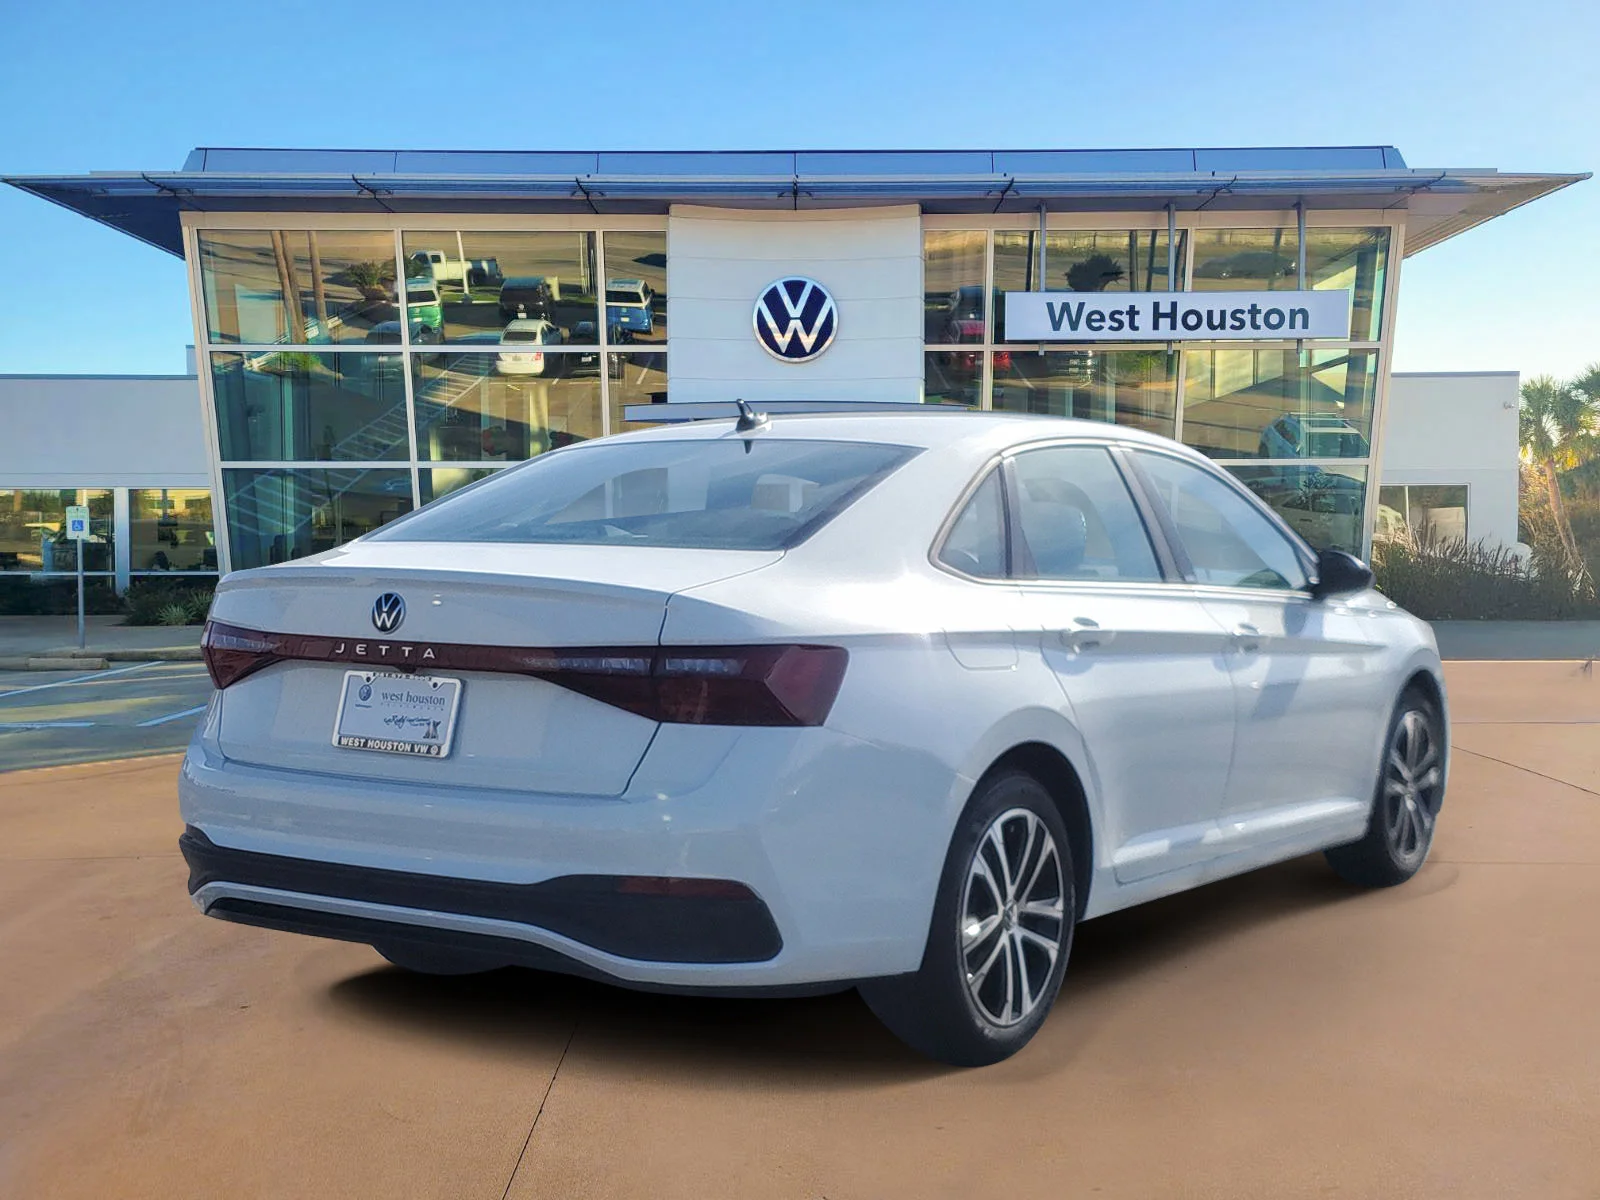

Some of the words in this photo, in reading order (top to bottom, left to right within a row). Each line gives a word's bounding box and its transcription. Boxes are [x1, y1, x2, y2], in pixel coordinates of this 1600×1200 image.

[753, 276, 838, 362] VW
[1046, 301, 1140, 332] West
[1152, 300, 1310, 332] Houston
[372, 592, 406, 635] VW
[335, 642, 436, 660] JETTA
[381, 691, 404, 702] west
[406, 690, 446, 706] houston
[340, 736, 366, 748] WEST
[367, 739, 412, 753] HOUSTON
[413, 744, 429, 755] VW
